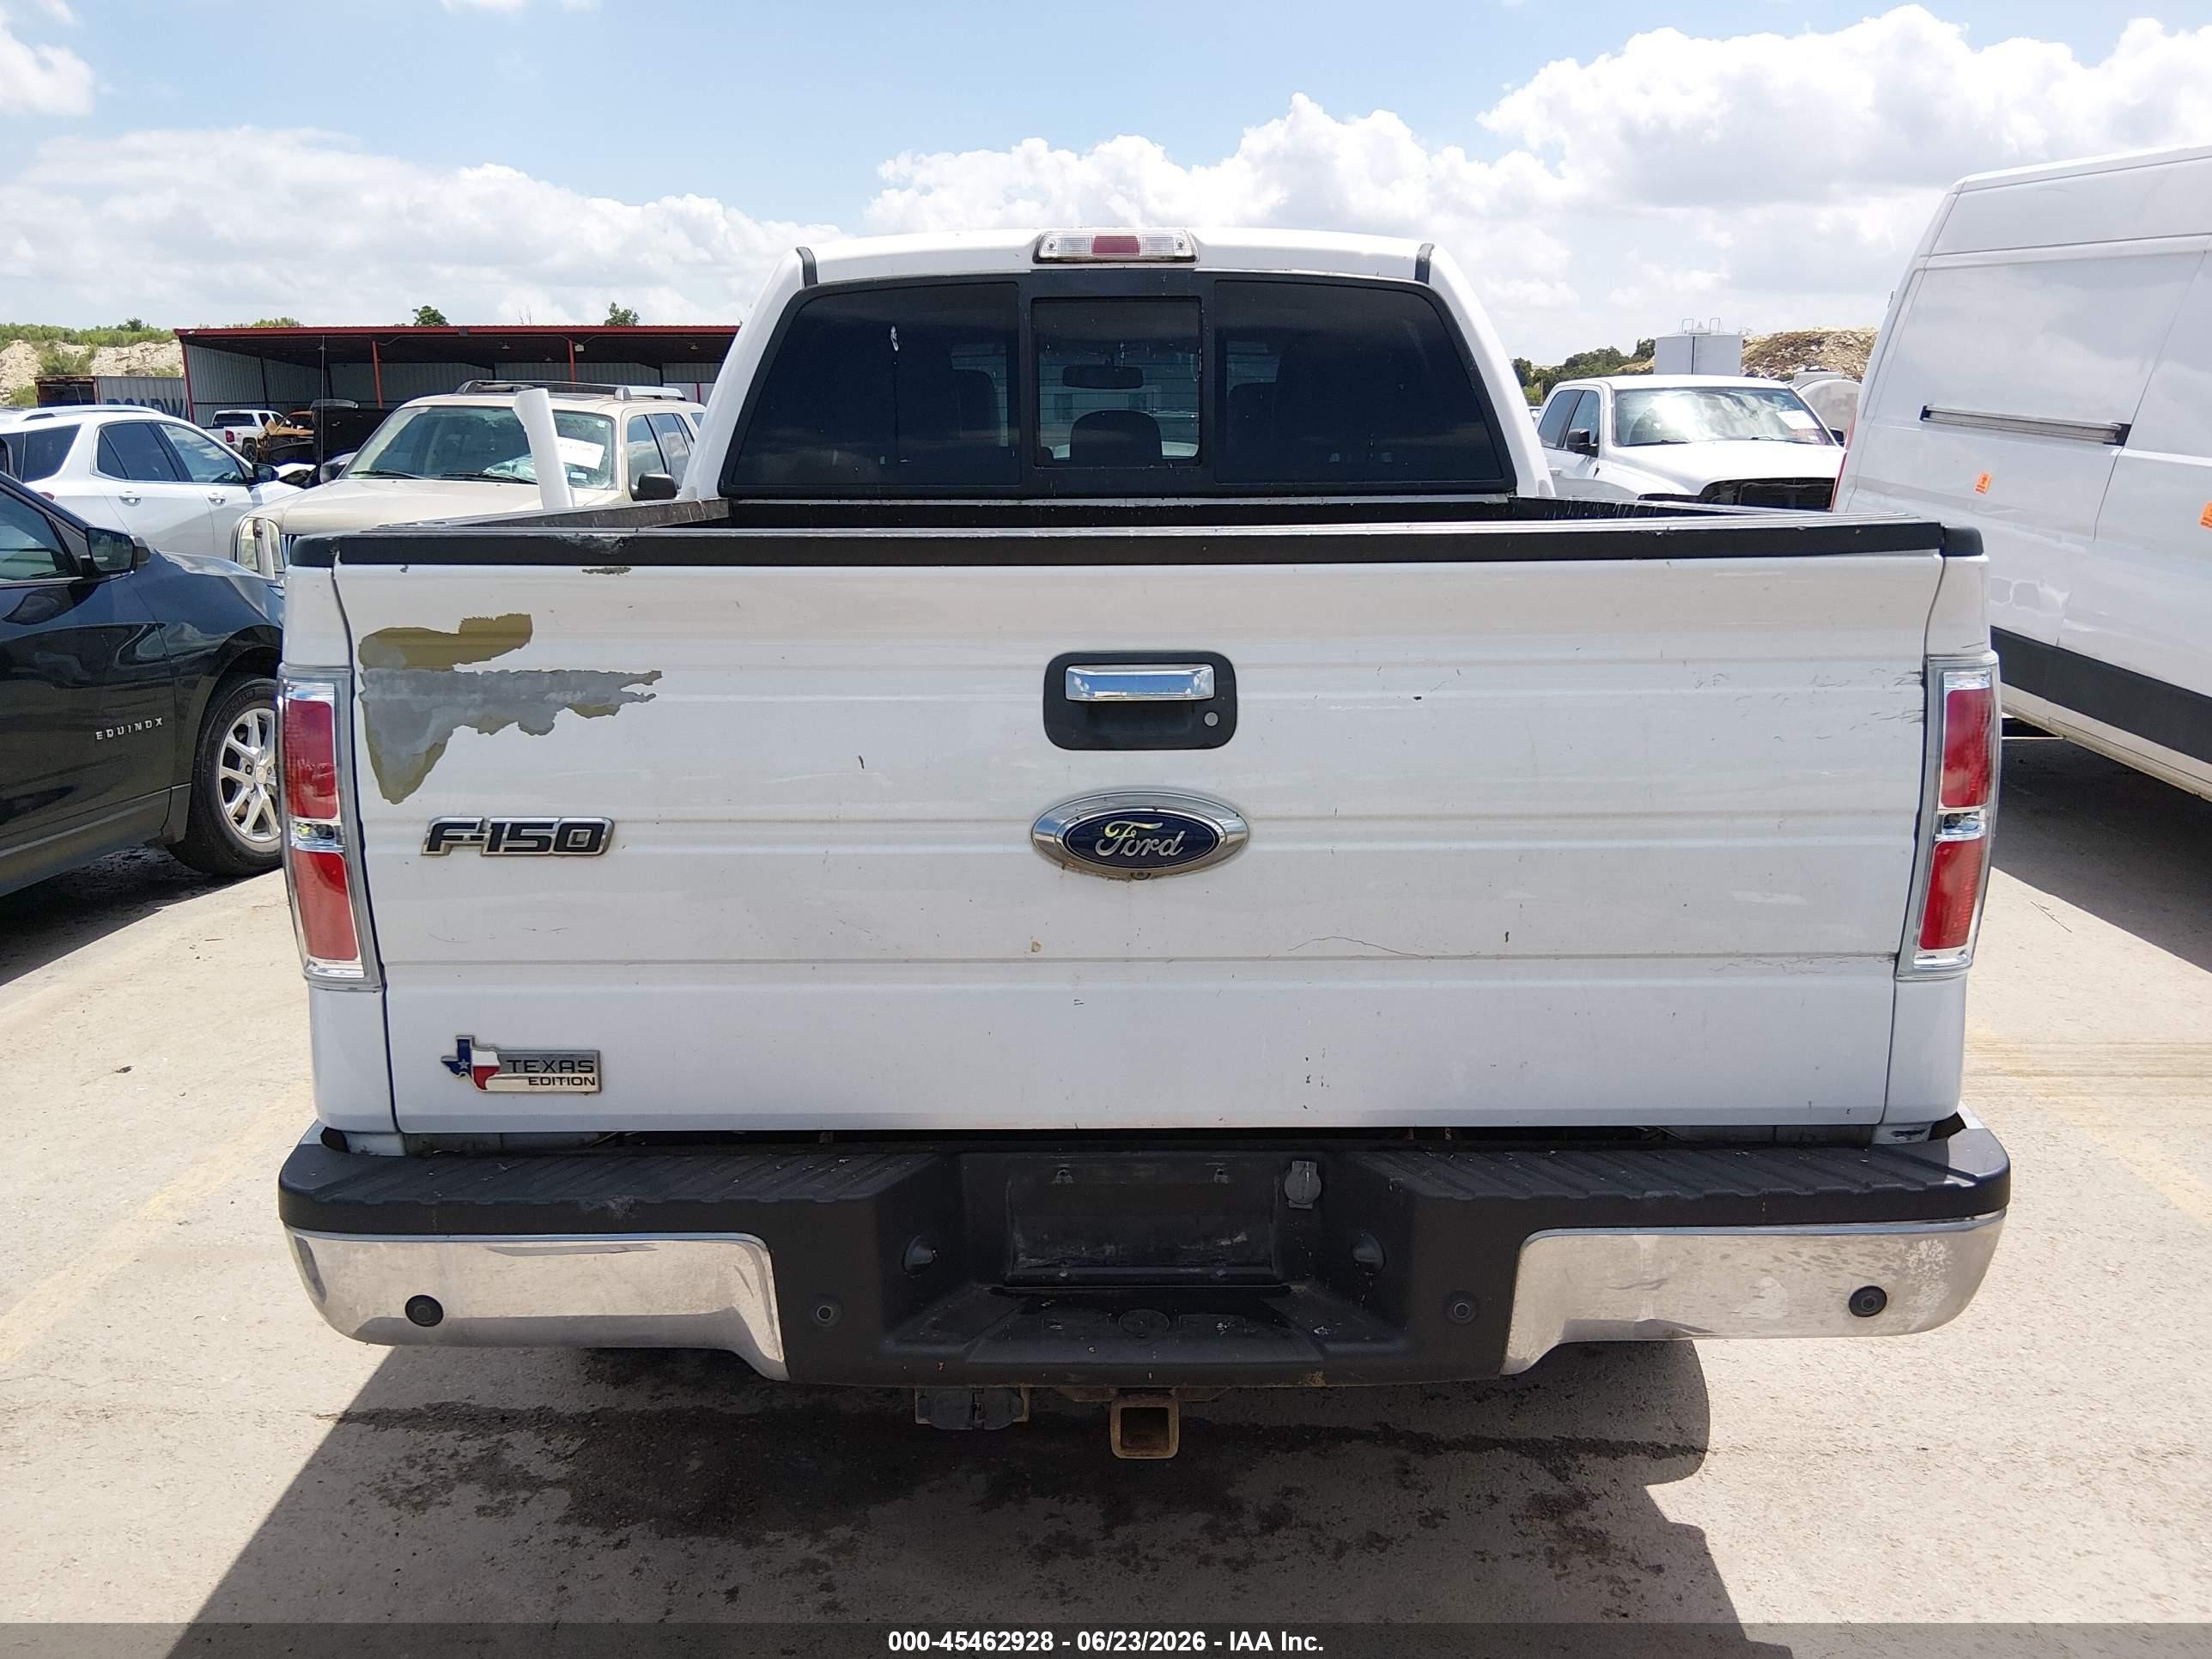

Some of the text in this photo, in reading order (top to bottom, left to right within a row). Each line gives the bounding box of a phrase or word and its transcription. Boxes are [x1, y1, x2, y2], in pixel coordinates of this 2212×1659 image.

[422, 817, 614, 856] F-150
[1095, 820, 1187, 857] Ford
[506, 1059, 595, 1073] TEXAS
[528, 1076, 596, 1086] EDITION
